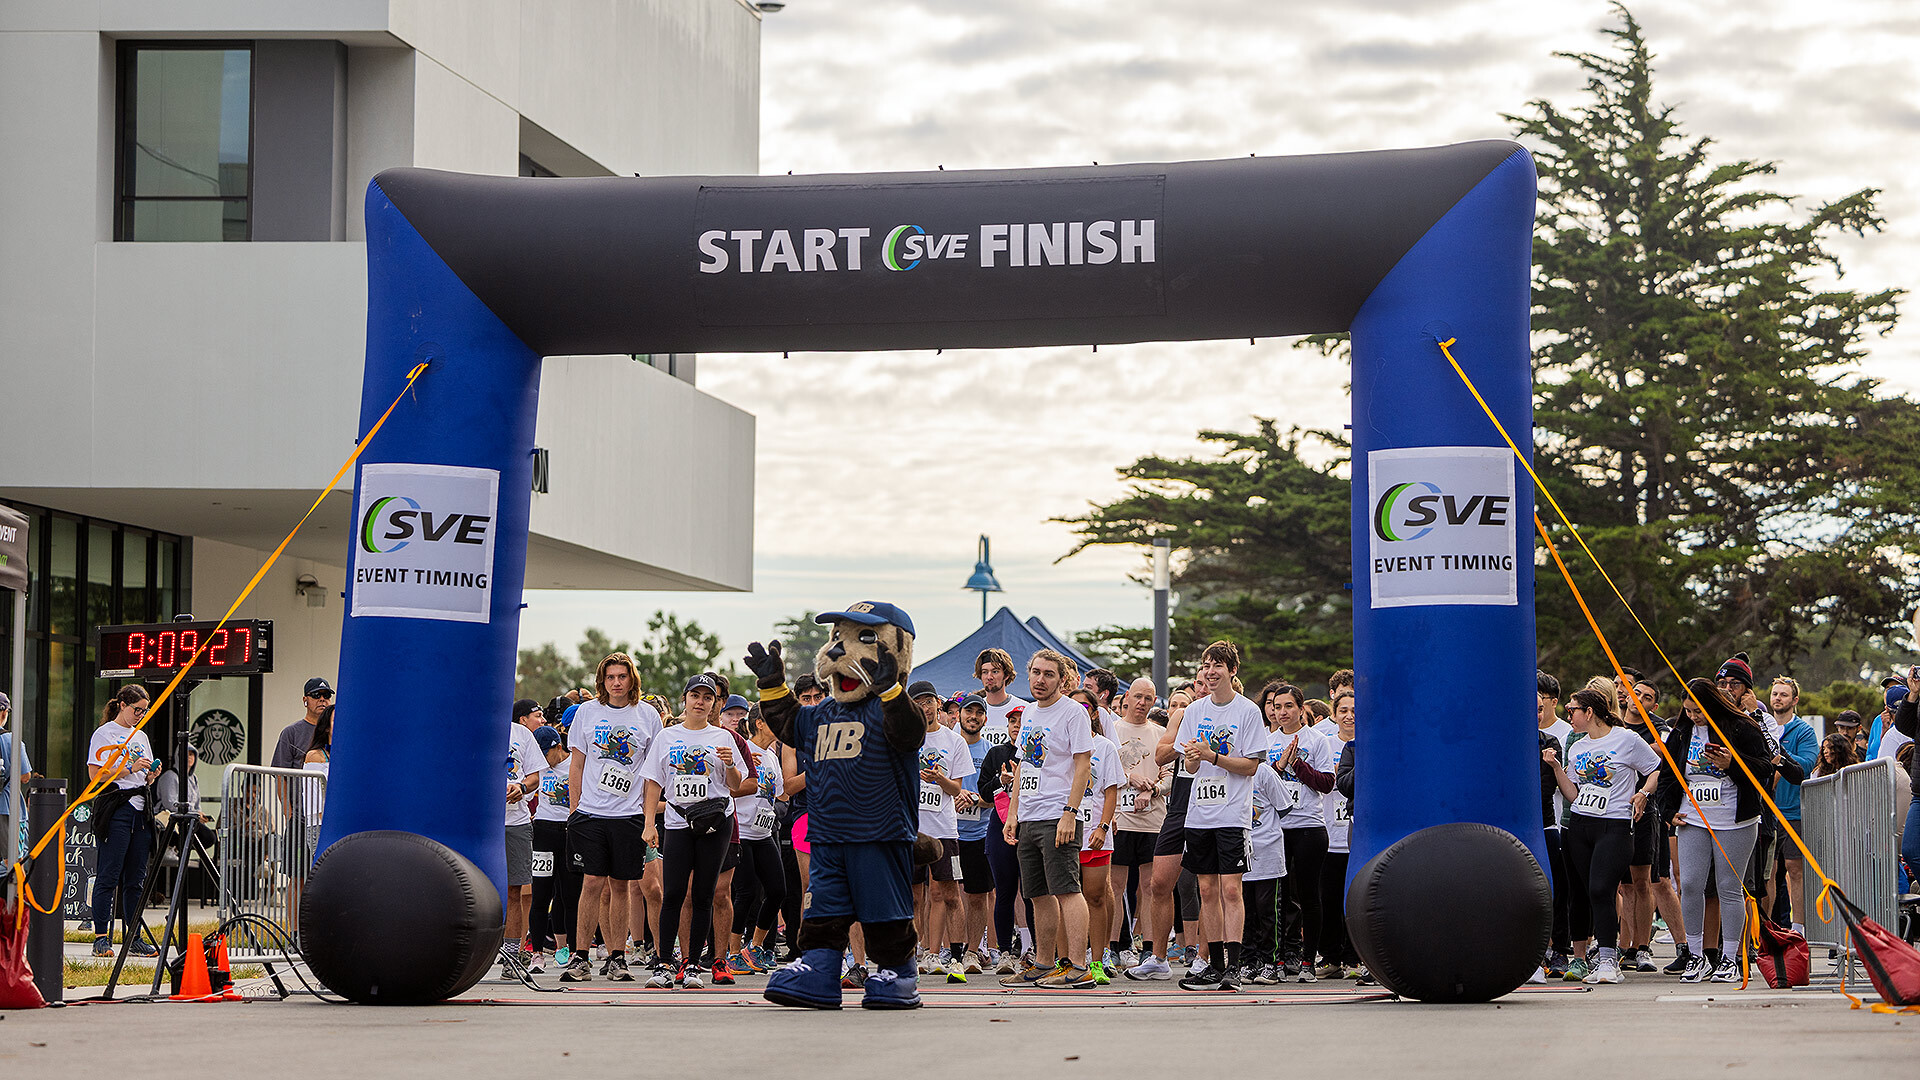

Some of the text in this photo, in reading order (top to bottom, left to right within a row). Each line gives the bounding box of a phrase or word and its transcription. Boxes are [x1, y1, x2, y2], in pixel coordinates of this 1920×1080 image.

[698, 219, 1156, 274] START SVE FINISH
[1403, 495, 1511, 526] SVE
[384, 510, 491, 545] SVE
[1374, 555, 1513, 573] EVENT TIMING
[356, 568, 488, 589] EVENT TIMING
[594, 731, 611, 745] 5K
[814, 721, 865, 762] MB
[669, 750, 686, 765] 5K
[542, 780, 557, 792] 5K
[600, 772, 632, 793] 1369
[675, 783, 706, 798] 1340
[1019, 776, 1038, 790] 255
[1196, 785, 1226, 800] 1164
[1578, 793, 1607, 810] 1170
